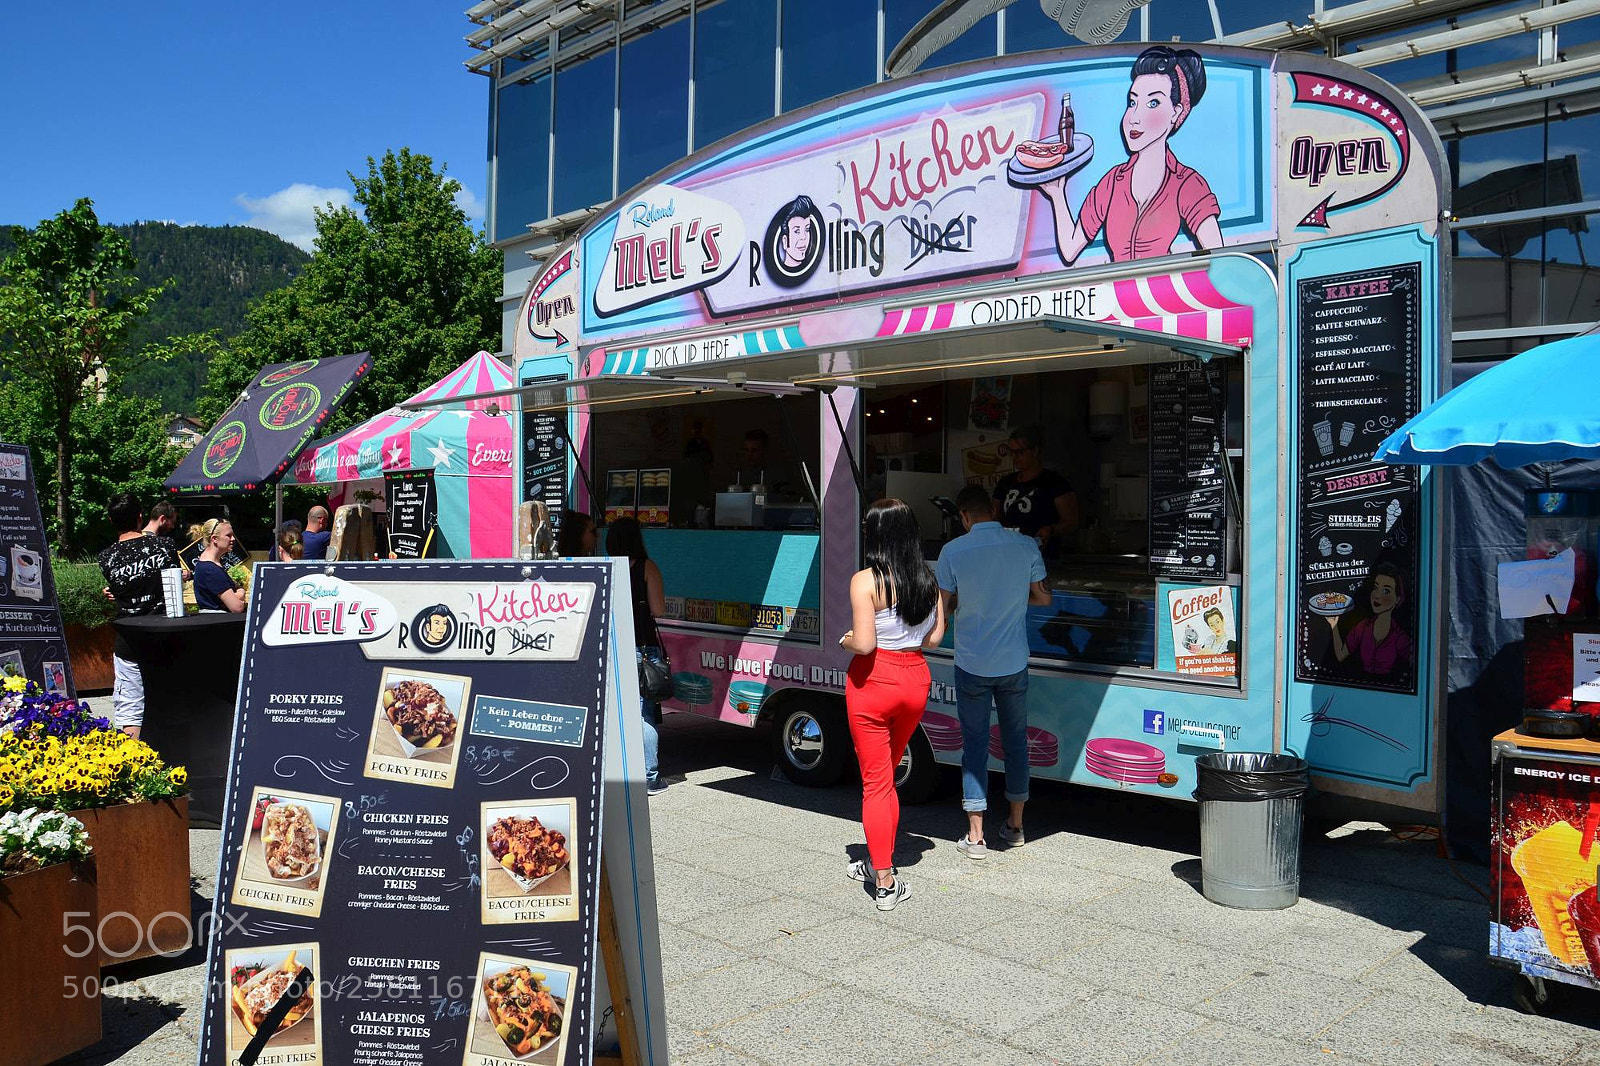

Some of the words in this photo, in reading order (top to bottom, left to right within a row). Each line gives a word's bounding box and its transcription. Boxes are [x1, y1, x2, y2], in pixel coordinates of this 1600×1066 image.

[1289, 136, 1390, 187] Open
[851, 118, 1014, 224] Kitchen
[627, 198, 675, 228] Roland
[614, 217, 722, 292] Mel's
[1326, 280, 1390, 300] KAFFEE
[536, 295, 575, 328] Open
[971, 295, 1042, 325] ORDER
[1053, 287, 1096, 317] HERE
[1315, 306, 1364, 318] CAPPUCCINO
[1315, 321, 1344, 331] KAFFEE
[1345, 317, 1382, 328] SCHWARZ
[1315, 334, 1353, 344] ESPRESSO
[654, 345, 679, 368] PICK
[1315, 349, 1351, 358] ESPRESSO
[1352, 344, 1391, 355] MACCIATO
[1315, 361, 1335, 372] CAFÉ
[1335, 362, 1346, 370] AU
[1347, 361, 1366, 370] LAIT
[1315, 377, 1336, 386] LATTE
[1337, 374, 1375, 384] MACCIATO
[1315, 397, 1383, 408] TRINKSCHOKOLADE
[471, 442, 513, 467] Every
[1326, 470, 1388, 492] DESSERT
[1350, 559, 1365, 567] der
[1306, 567, 1370, 581] KUCHENVITRINE
[296, 582, 340, 600] Roland
[478, 583, 579, 627] Kitchen
[1172, 587, 1223, 621] Coffee!
[281, 601, 380, 635] Mel's
[5, 623, 58, 633] Kuchenvitrine
[1202, 657, 1212, 665] not
[701, 651, 729, 669] We
[729, 655, 762, 676] love
[764, 661, 808, 682] Food,
[811, 666, 847, 686] Drin
[1203, 665, 1225, 674] another
[269, 694, 309, 704] PORKY
[309, 694, 344, 705] FRIES
[291, 708, 306, 716] Pulled
[305, 708, 319, 716] Pork
[322, 708, 346, 716] Coleslaw
[488, 706, 510, 718] Kein
[511, 709, 539, 720] Leben
[540, 713, 564, 723] ohne
[371, 762, 411, 776] PORKY
[414, 767, 448, 780] FRIES
[1514, 767, 1566, 780] ENERGY
[1568, 773, 1591, 783] ICE
[362, 812, 414, 824] CHICKEN
[416, 814, 449, 825] FRIES
[362, 828, 387, 836] Pommes
[374, 836, 392, 846] Honey
[392, 837, 415, 845] Mustard
[357, 865, 446, 878] BACON/CHEESE
[383, 879, 417, 890] FRIES
[239, 887, 284, 902] CHICKEN
[285, 895, 315, 908] FRIES
[358, 892, 383, 901] Pommes
[386, 893, 405, 901] Bacon
[373, 901, 396, 909] Cheddar
[419, 903, 433, 911] BBQ
[432, 904, 450, 912] Sauce
[488, 898, 572, 910] BACON/CHEESE
[514, 911, 545, 921] FRIES
[347, 956, 405, 969] GRIECHEN
[407, 959, 441, 971] FRIES
[370, 973, 395, 981] Pommes
[397, 973, 416, 982] Gyros
[356, 1010, 426, 1025] JALAPENOS
[350, 1024, 395, 1036] CHEESE
[396, 1026, 431, 1038] FRIES
[358, 1041, 383, 1049] Pommes
[231, 1055, 284, 1066] GCHEN
[287, 1052, 317, 1063] FRIES
